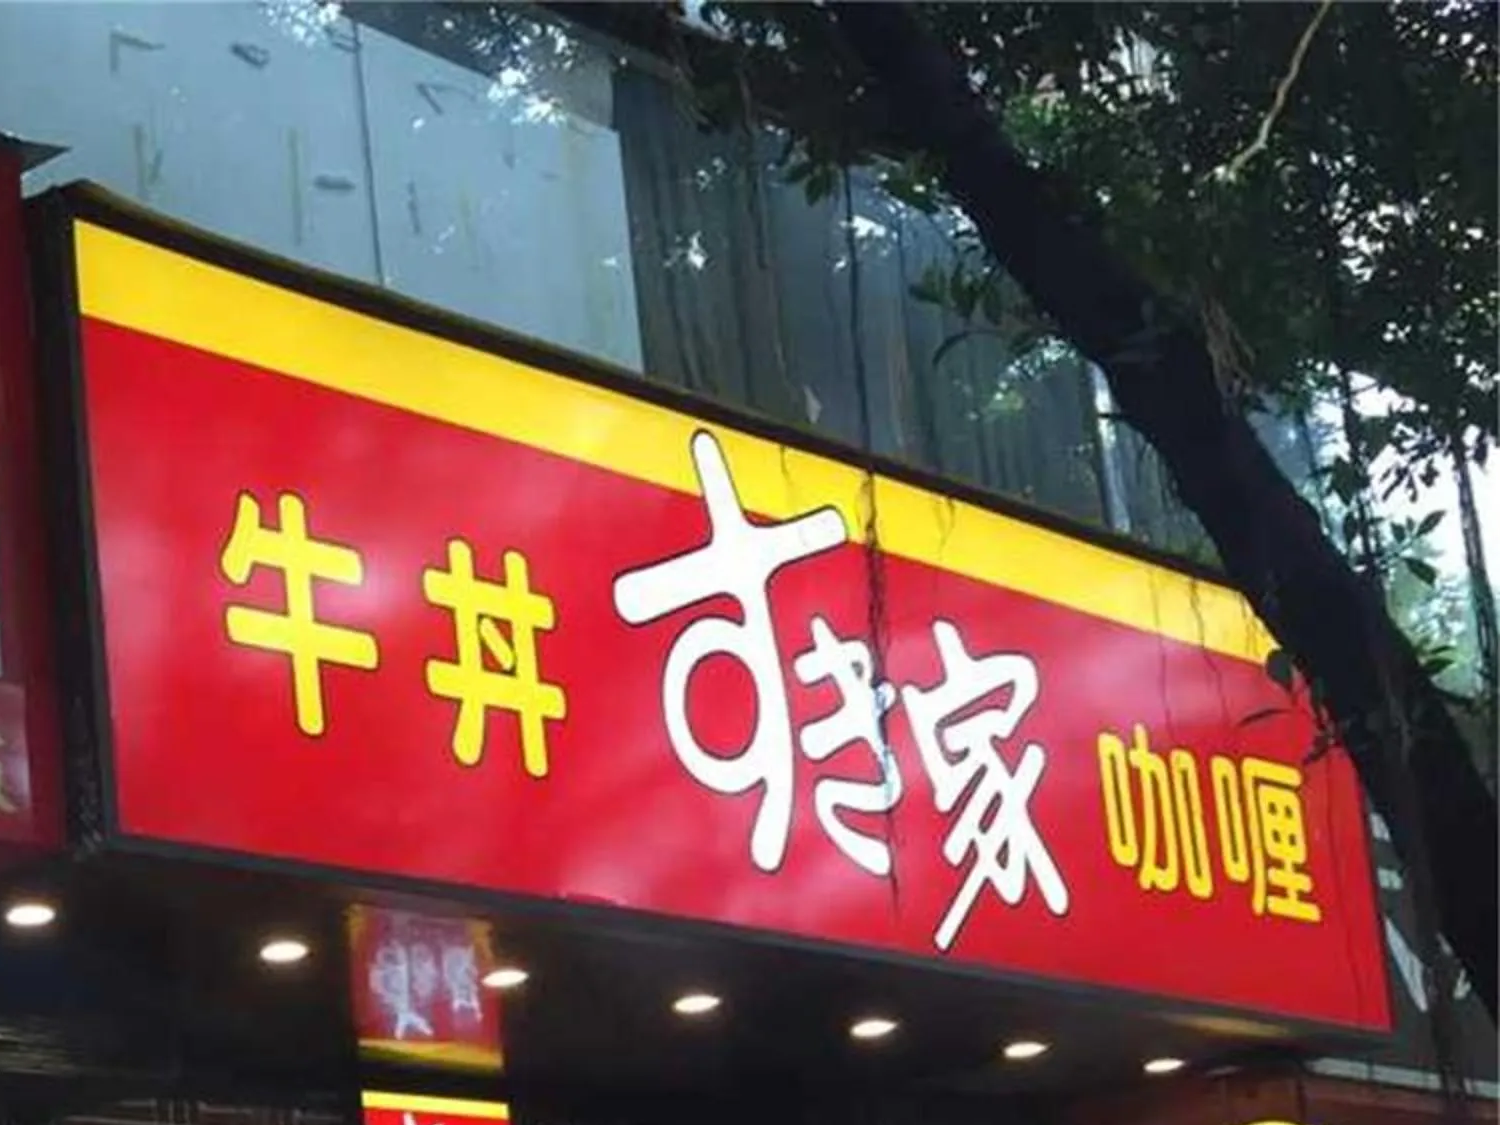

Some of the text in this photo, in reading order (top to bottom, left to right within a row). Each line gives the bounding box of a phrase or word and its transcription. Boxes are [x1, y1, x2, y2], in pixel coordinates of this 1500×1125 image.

[220, 428, 1323, 952] 牛丼 すき家 咖喱
